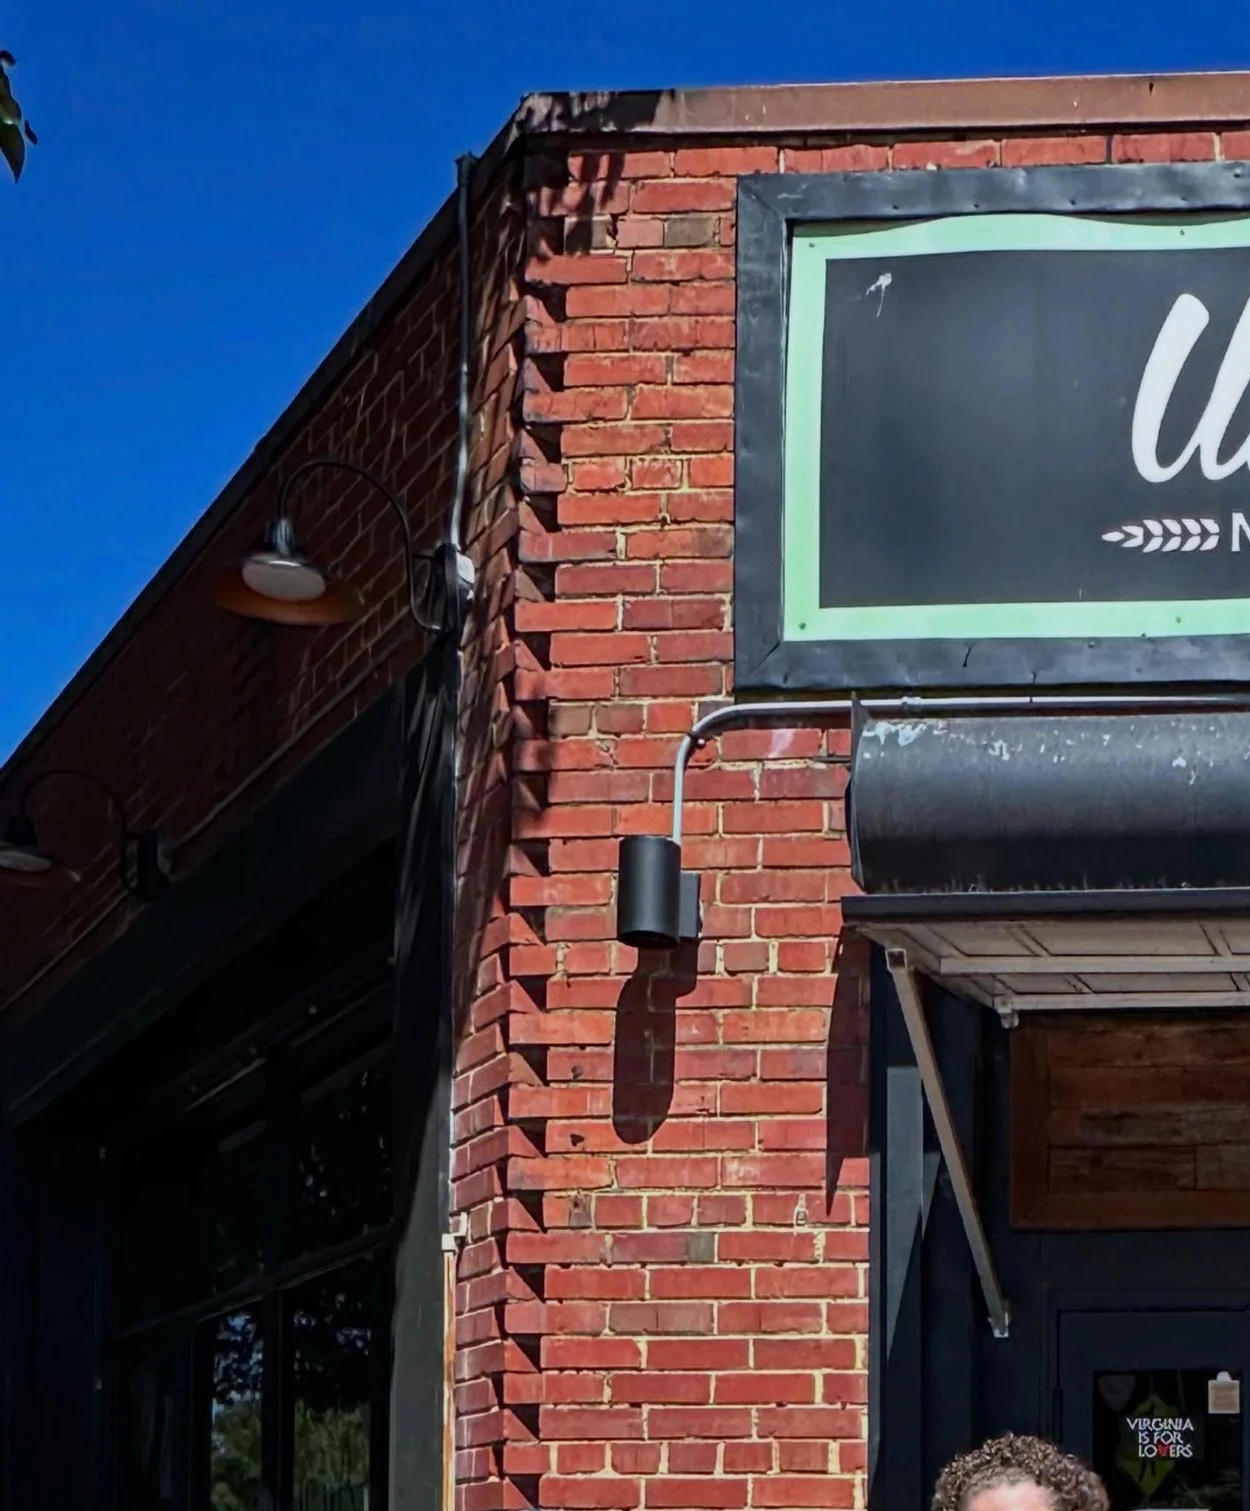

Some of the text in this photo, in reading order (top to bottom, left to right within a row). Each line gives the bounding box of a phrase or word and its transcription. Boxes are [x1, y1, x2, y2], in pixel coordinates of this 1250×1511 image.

[1126, 1417, 1194, 1431] VIRGINIA
[1138, 1431, 1183, 1445] IS FOR
